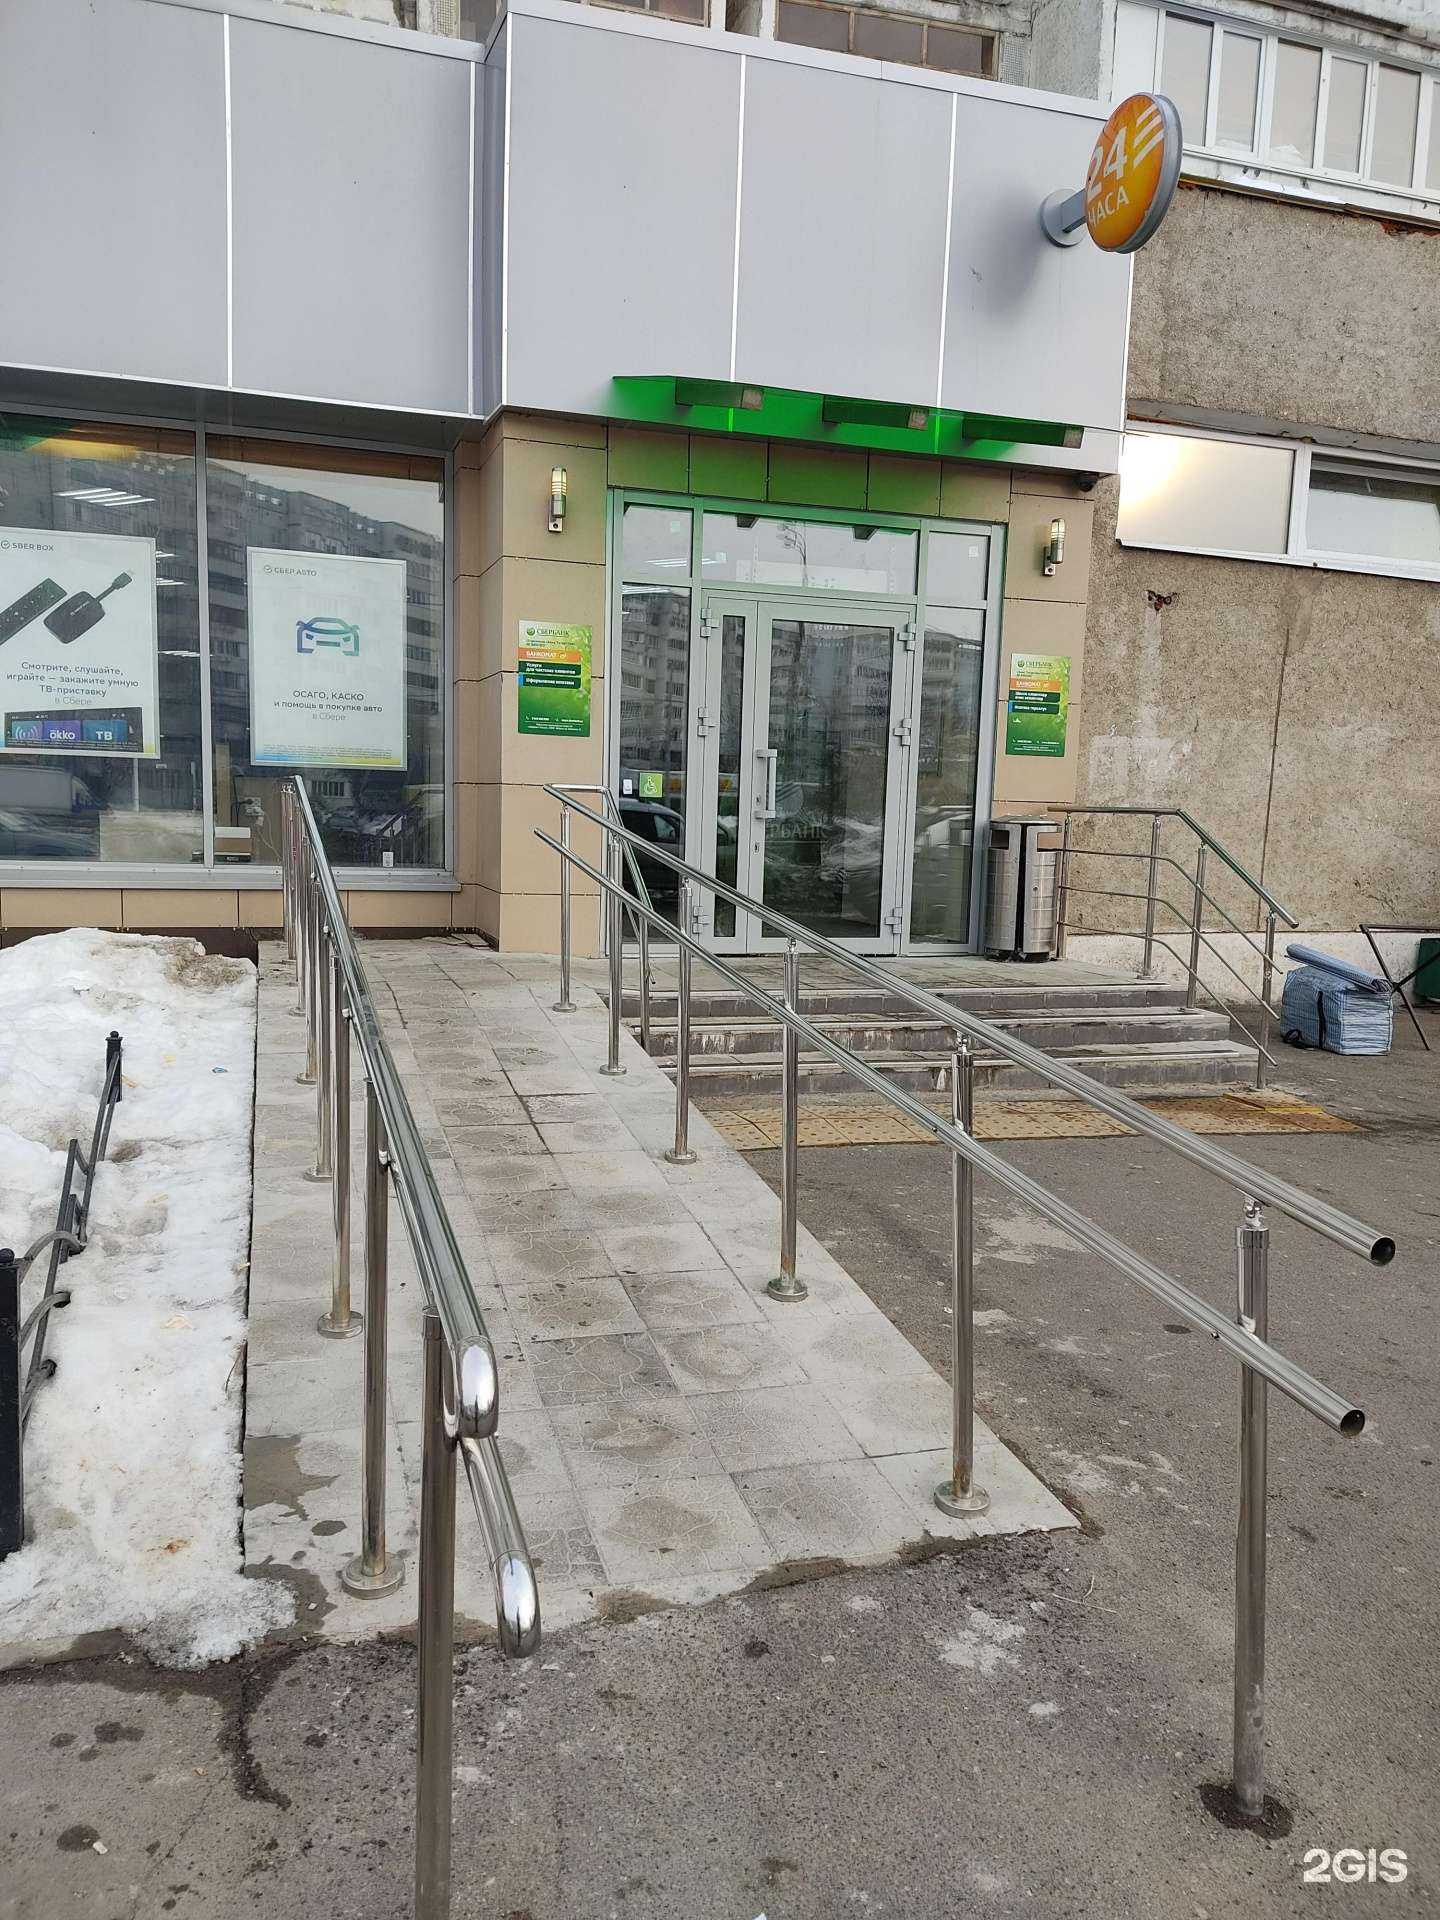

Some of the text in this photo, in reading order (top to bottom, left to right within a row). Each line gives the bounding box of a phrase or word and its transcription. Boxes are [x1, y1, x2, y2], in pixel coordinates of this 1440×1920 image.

[1087, 126, 1128, 204] 24
[1088, 185, 1130, 226] ЧАСА
[21, 661, 124, 676] Смотрите, слушайте,
[6, 672, 46, 683] играйте
[60, 676, 105, 685] закажите
[107, 679, 139, 688] умную
[40, 684, 107, 698] ТВ-приставку
[292, 690, 364, 701] ОСАГО, КАСКО
[281, 701, 317, 710] помощь
[325, 703, 362, 713] покупке
[95, 730, 113, 741] ТВ
